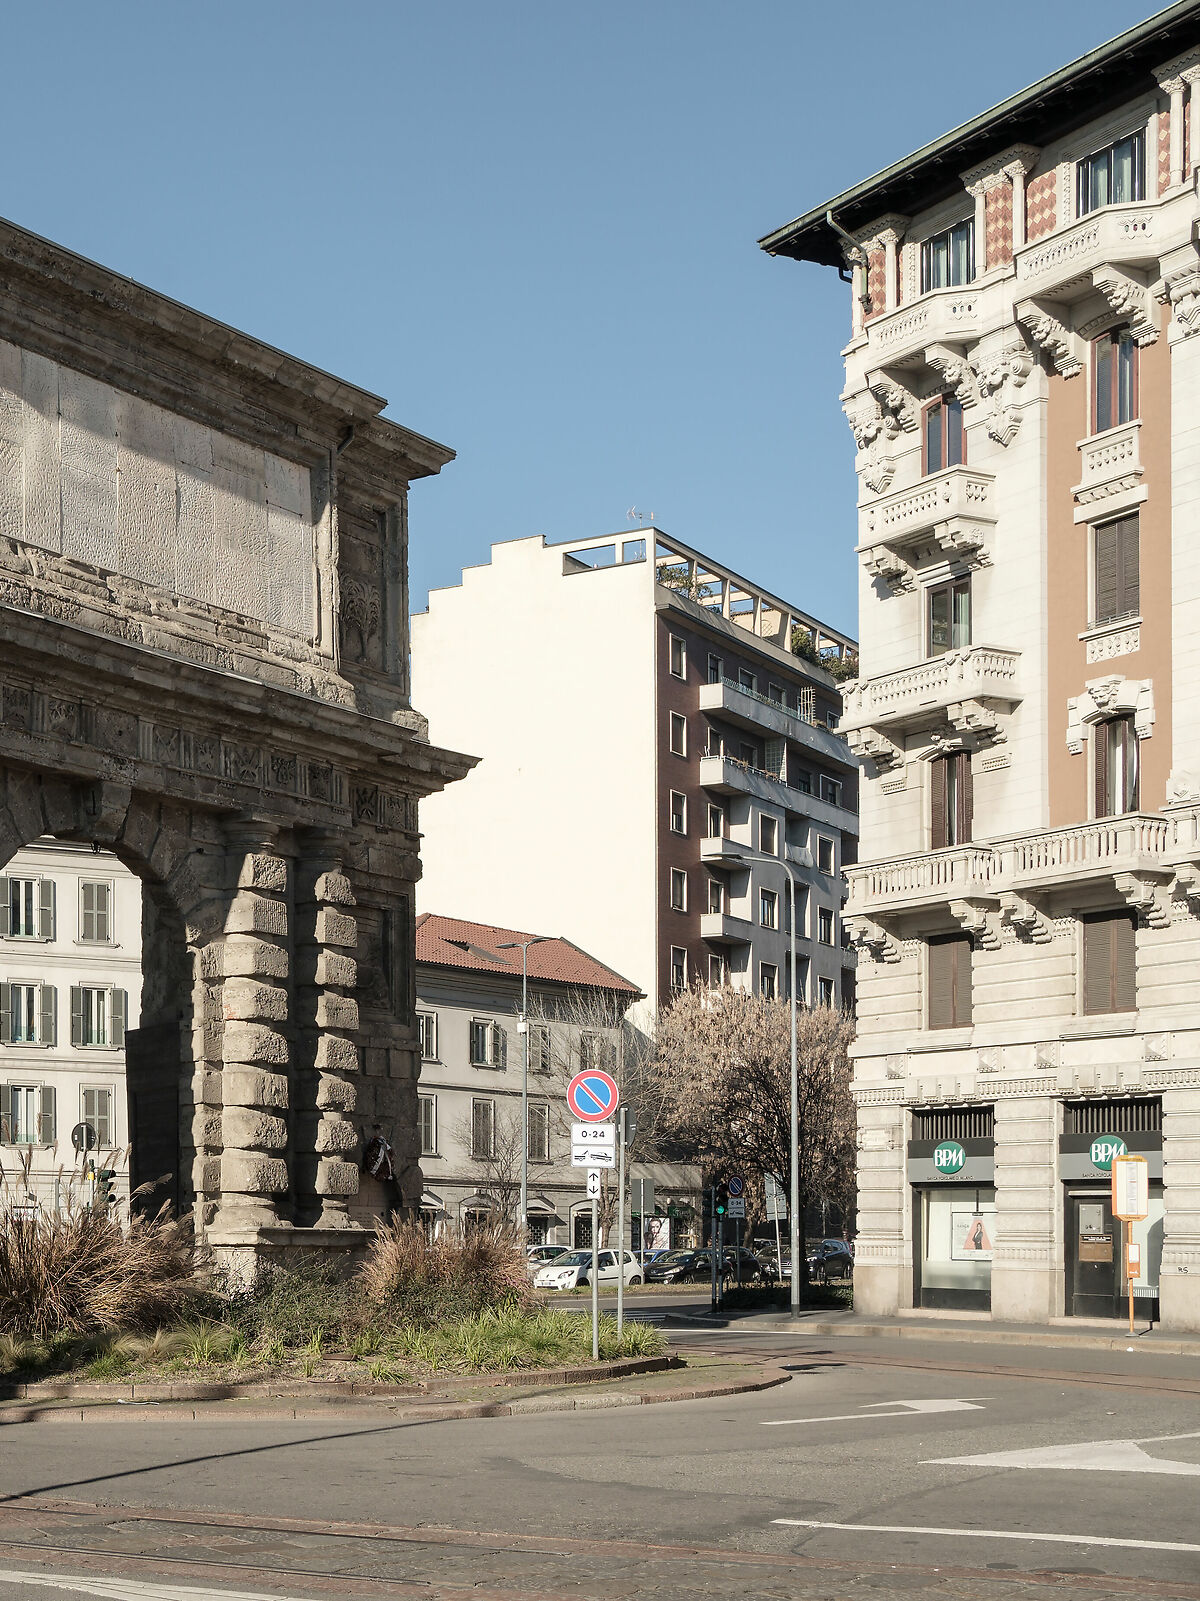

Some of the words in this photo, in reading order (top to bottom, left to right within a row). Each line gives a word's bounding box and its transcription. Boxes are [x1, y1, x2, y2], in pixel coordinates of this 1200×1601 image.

[581, 1130, 605, 1138] 0-24
[934, 1148, 964, 1167] BPM
[1091, 1143, 1125, 1163] BPM
